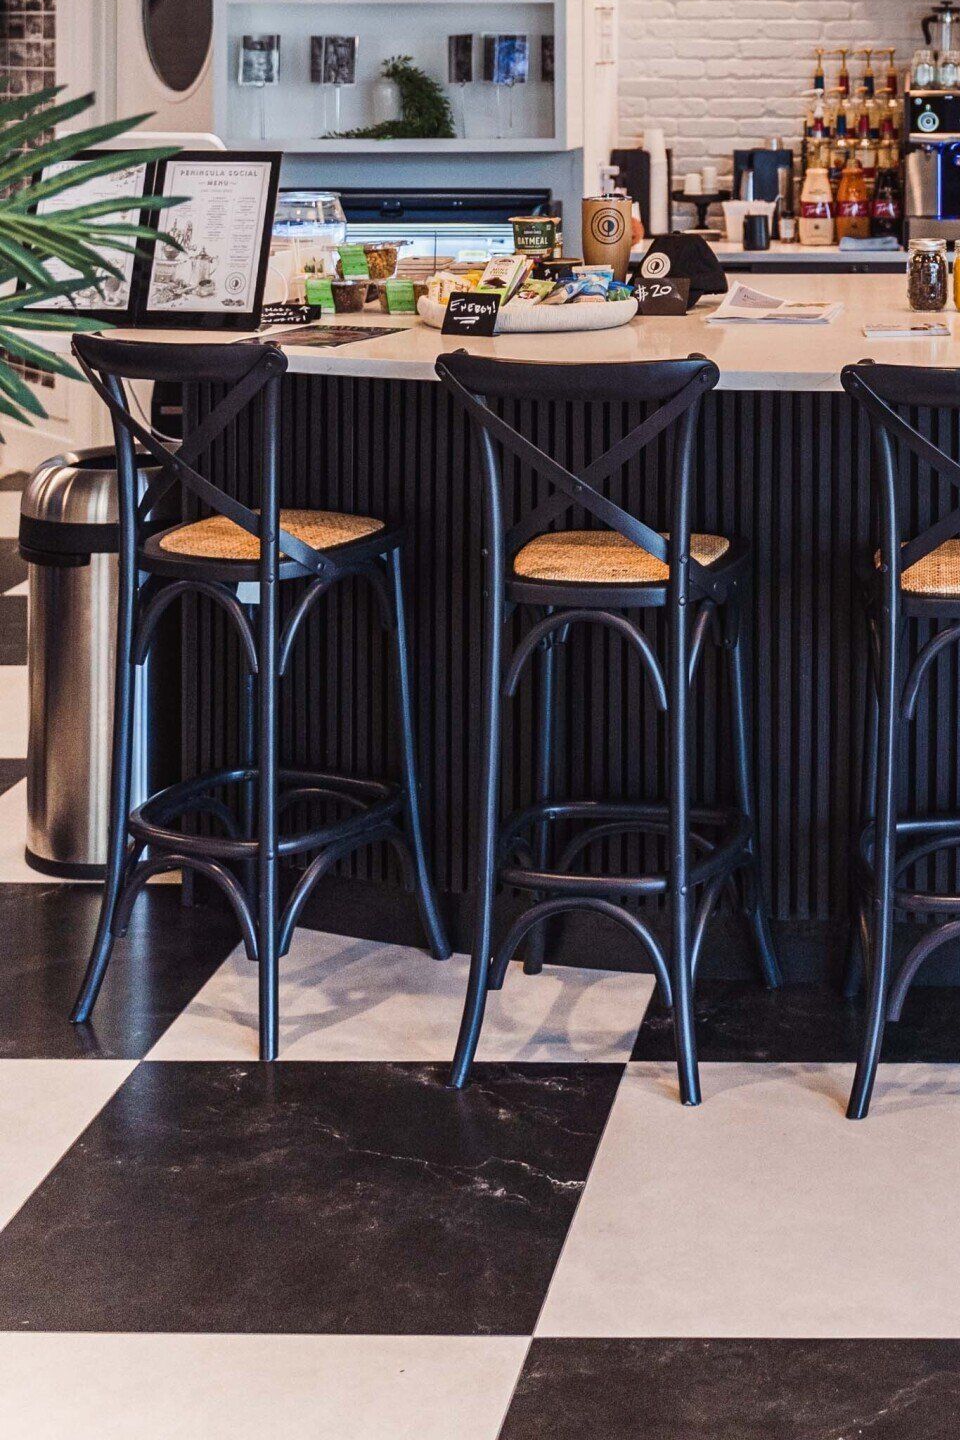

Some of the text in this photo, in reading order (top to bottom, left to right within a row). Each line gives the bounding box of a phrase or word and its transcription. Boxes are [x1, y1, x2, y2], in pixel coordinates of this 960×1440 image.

[228, 169, 258, 177] SOCIAL
[517, 237, 549, 245] OATMEAL
[635, 284, 673, 302] $20
